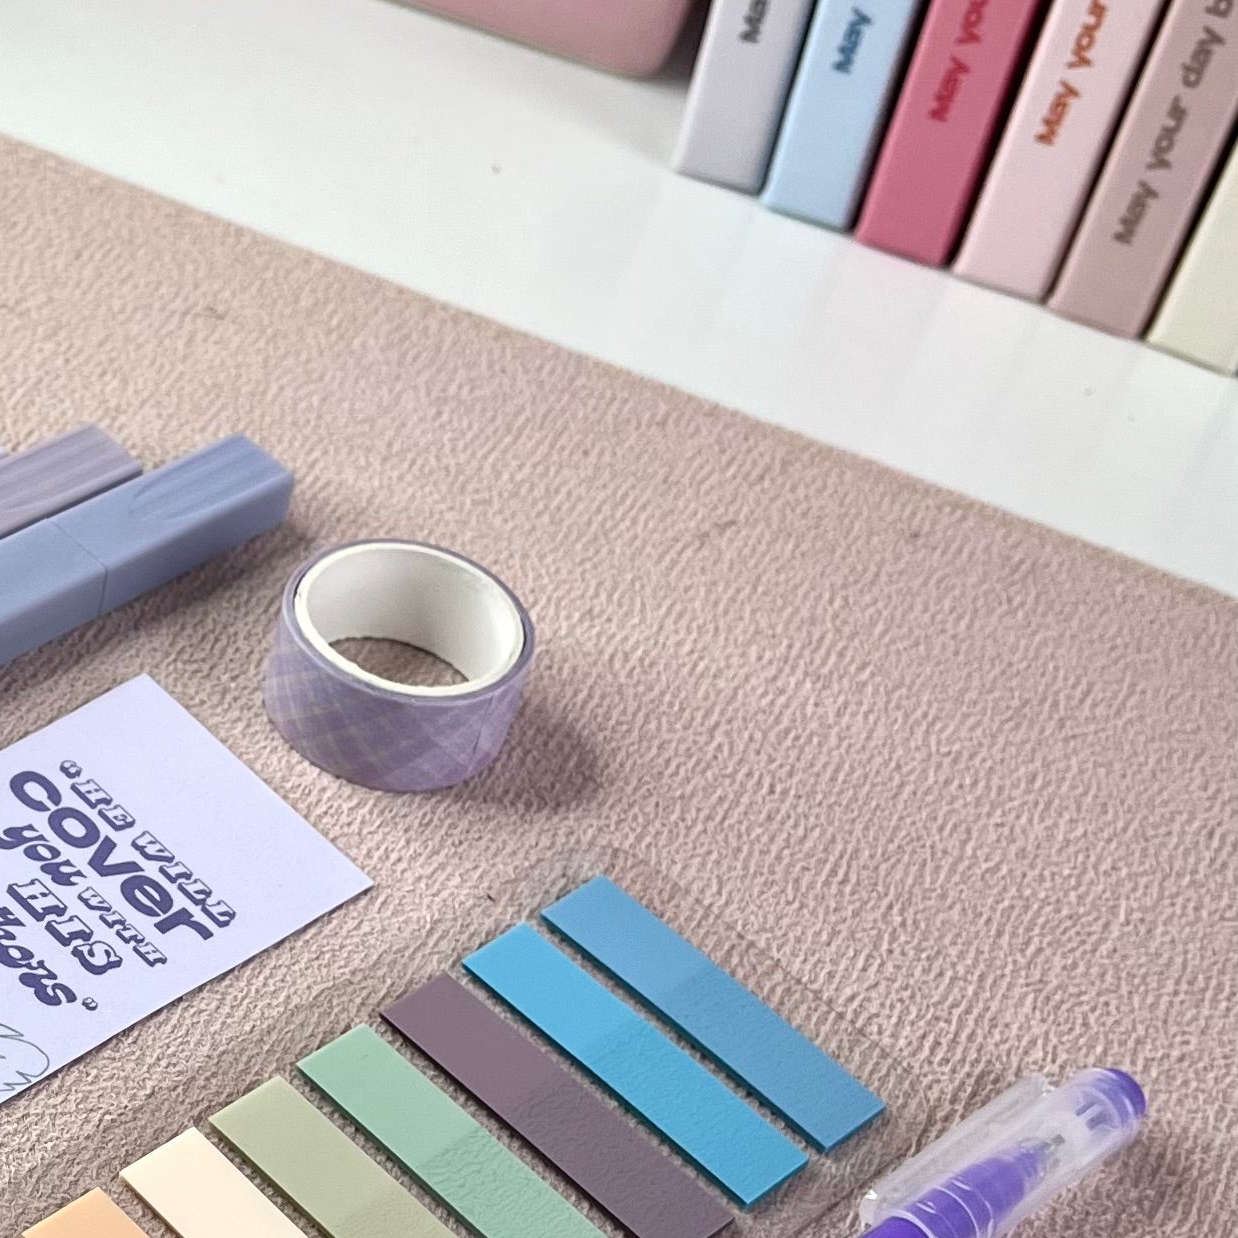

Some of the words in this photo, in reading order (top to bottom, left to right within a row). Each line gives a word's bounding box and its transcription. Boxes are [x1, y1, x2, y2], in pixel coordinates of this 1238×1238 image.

[832, 6, 873, 73] May
[927, 54, 970, 122] May
[955, 0, 989, 44] yo
[1034, 79, 1081, 146] May
[1113, 179, 1160, 246] May
[1146, 94, 1188, 170] your
[1182, 25, 1226, 89] day
[9, 771, 214, 941] cover
[131, 831, 236, 928] WILL
[6, 878, 123, 975] HIS
[78, 887, 167, 967] WITH
